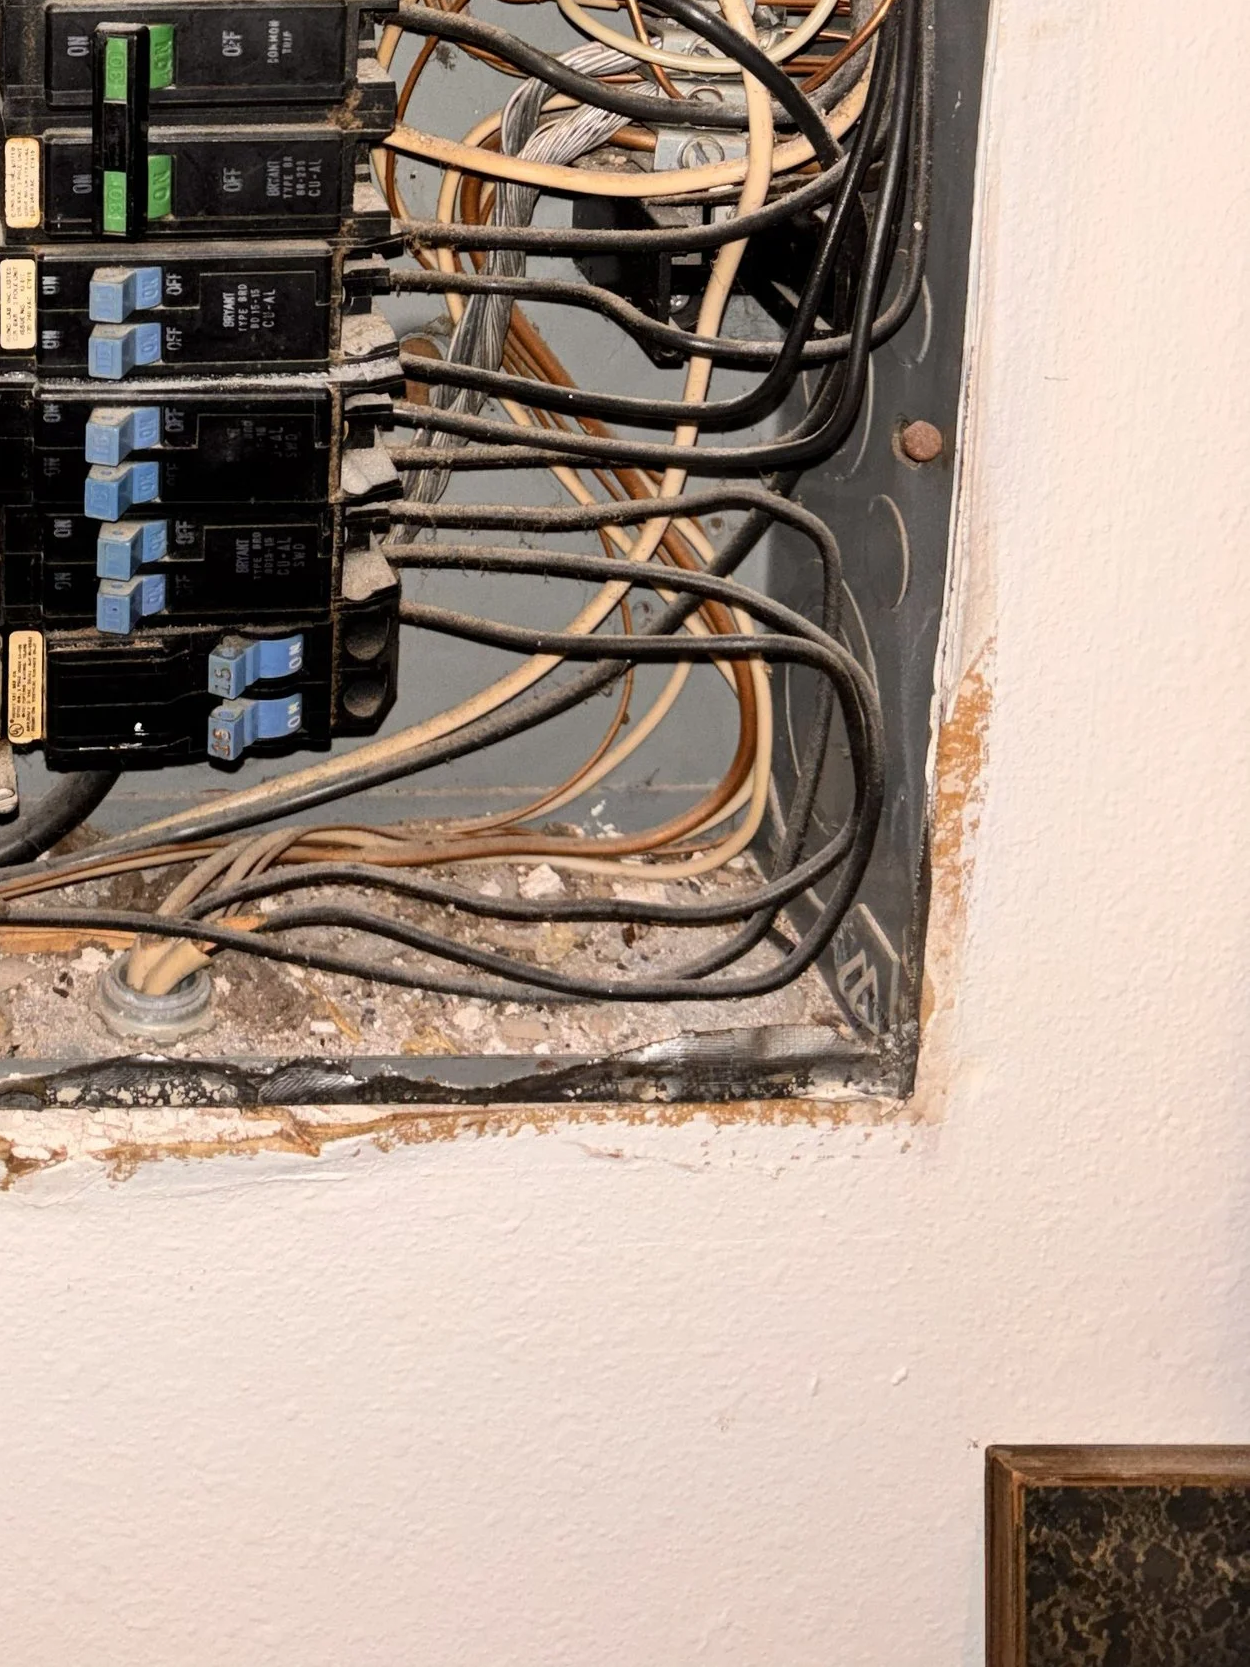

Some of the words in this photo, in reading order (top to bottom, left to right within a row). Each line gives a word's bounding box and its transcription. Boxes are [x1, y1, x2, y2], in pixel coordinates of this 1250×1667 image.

[67, 36, 90, 57] ON
[154, 42, 170, 70] ON
[222, 30, 243, 57] OFF
[73, 174, 92, 194] ON
[153, 170, 170, 201] ON
[223, 168, 243, 193] OFF
[266, 161, 280, 196] BRYANT
[283, 175, 293, 199] TYPE
[308, 158, 322, 197] CU-AL
[166, 272, 183, 296] OFF
[238, 283, 248, 303] BRD
[223, 292, 236, 328] BRYANT
[238, 308, 248, 332] TYPE
[263, 289, 275, 328] CU-AL
[166, 326, 182, 351] OFF
[43, 404, 61, 423] ON
[165, 408, 185, 433] OFF
[44, 457, 61, 477] ON
[54, 519, 71, 538] ON
[175, 521, 195, 545] OFF
[236, 538, 249, 573] BRYANT
[293, 543, 306, 567] SWD
[55, 572, 71, 590] ON
[289, 642, 301, 669] ON
[214, 668, 231, 694] 15
[288, 702, 300, 728] ON
[212, 727, 230, 756] 15
